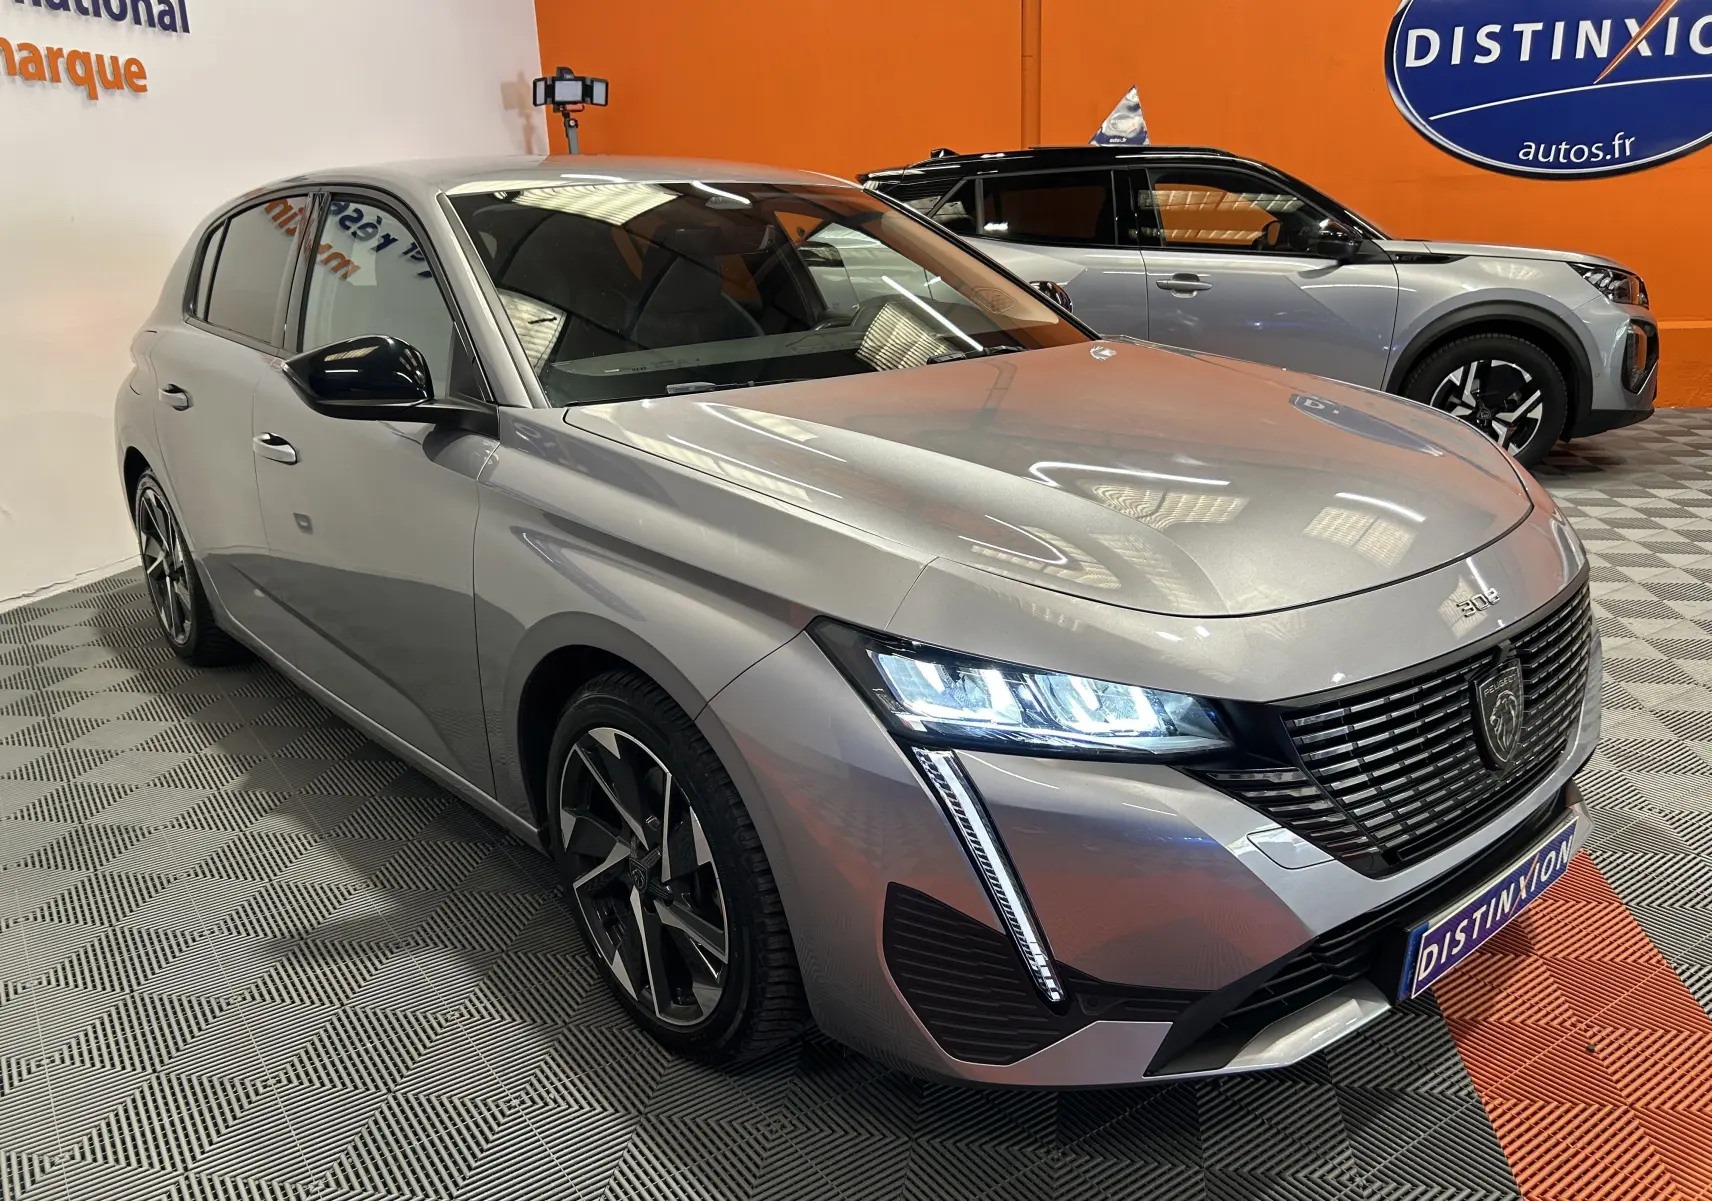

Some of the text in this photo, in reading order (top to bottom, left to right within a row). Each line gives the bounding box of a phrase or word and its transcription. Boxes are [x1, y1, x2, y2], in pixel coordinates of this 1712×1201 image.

[1518, 131, 1636, 163] autos.fr
[1456, 587, 1500, 618] 308
[1483, 673, 1517, 698] PEUGEOT
[1417, 834, 1573, 982] DISTINXION
